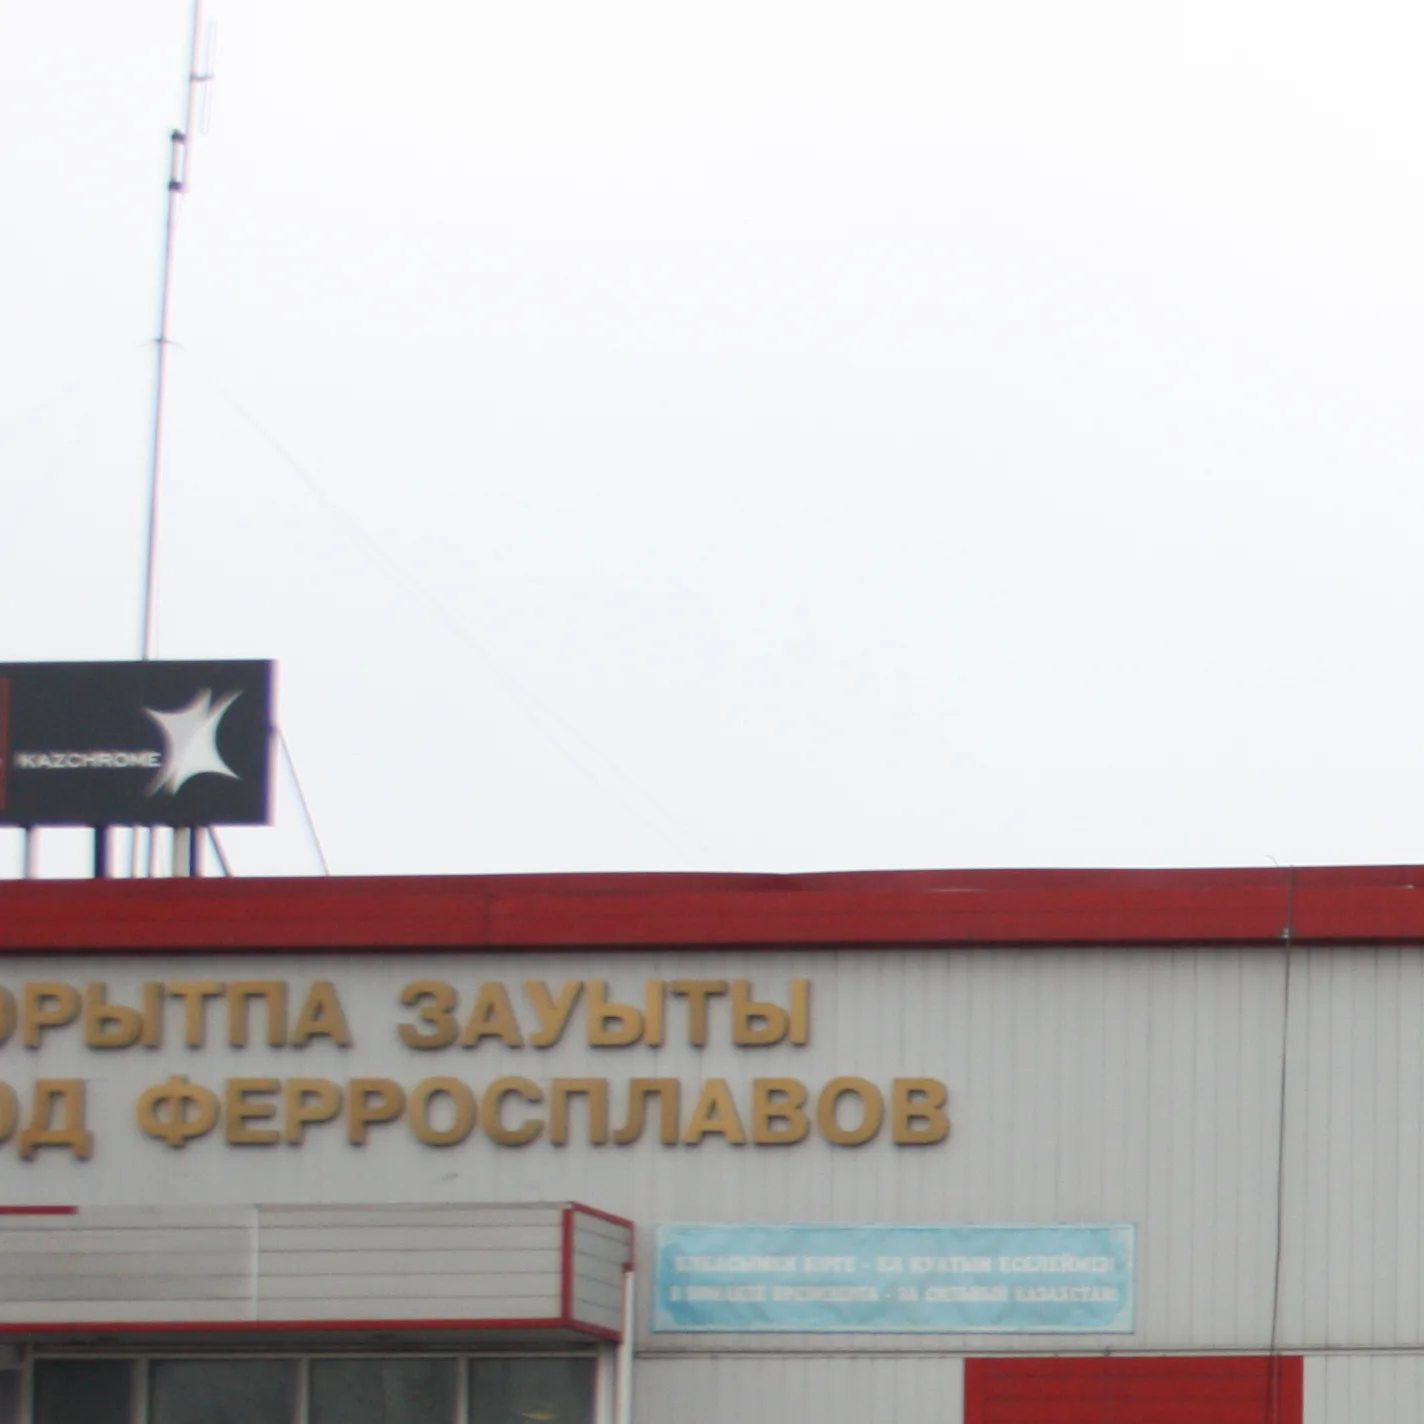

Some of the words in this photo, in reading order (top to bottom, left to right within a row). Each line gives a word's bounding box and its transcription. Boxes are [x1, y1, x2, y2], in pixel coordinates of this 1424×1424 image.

[18, 751, 162, 769] KAZCHROME
[0, 980, 352, 1050] РЫТПА
[397, 978, 811, 1050] ЗАУЫТЫ
[137, 1075, 950, 1148] ФЕРРОСПЛАВОВ
